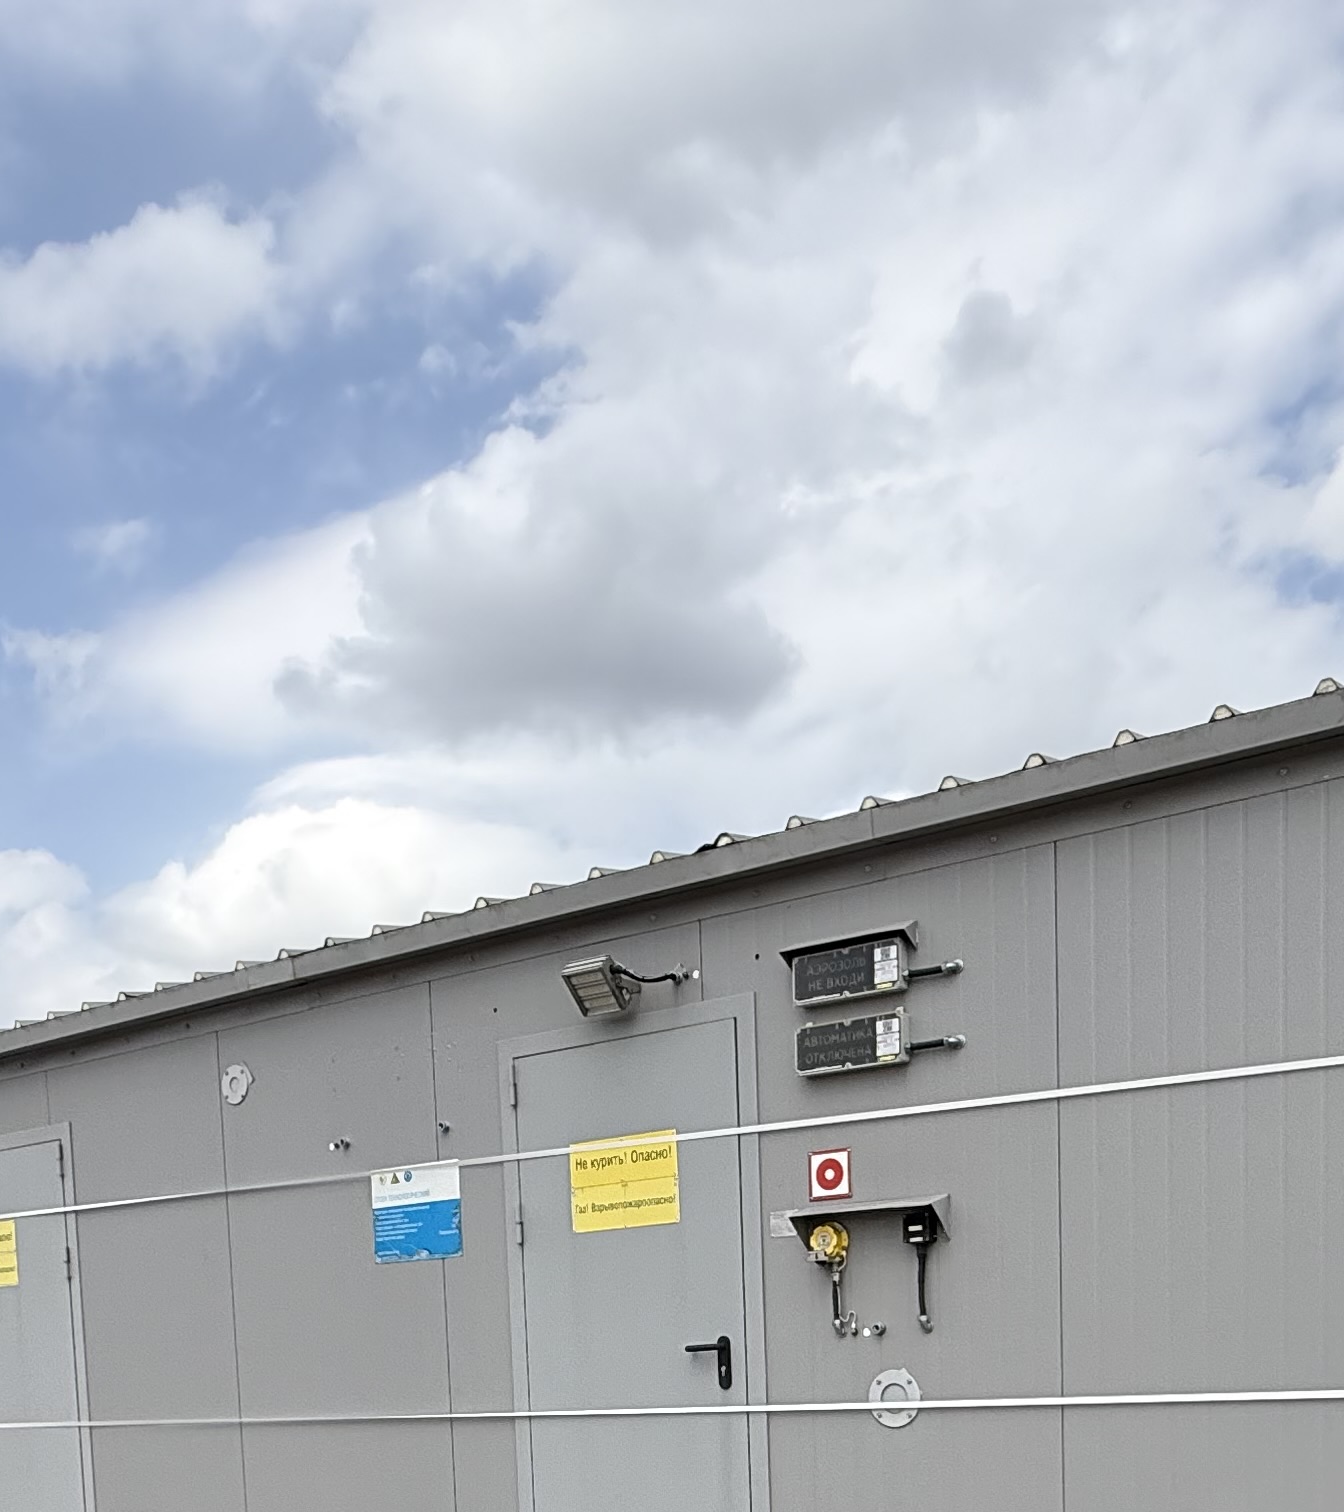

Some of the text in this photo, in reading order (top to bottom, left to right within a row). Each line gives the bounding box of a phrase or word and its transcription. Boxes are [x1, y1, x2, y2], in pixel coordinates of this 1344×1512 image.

[807, 957, 866, 976] АЭРОЗОЛЬ
[808, 979, 823, 992] НЕ
[826, 971, 865, 990] ВХОДИ
[804, 1027, 874, 1048] АВТОМАТИКА
[805, 1045, 872, 1065] ОТКЛЮЧЕНА
[575, 1145, 672, 1171] Не курить! Опасно!
